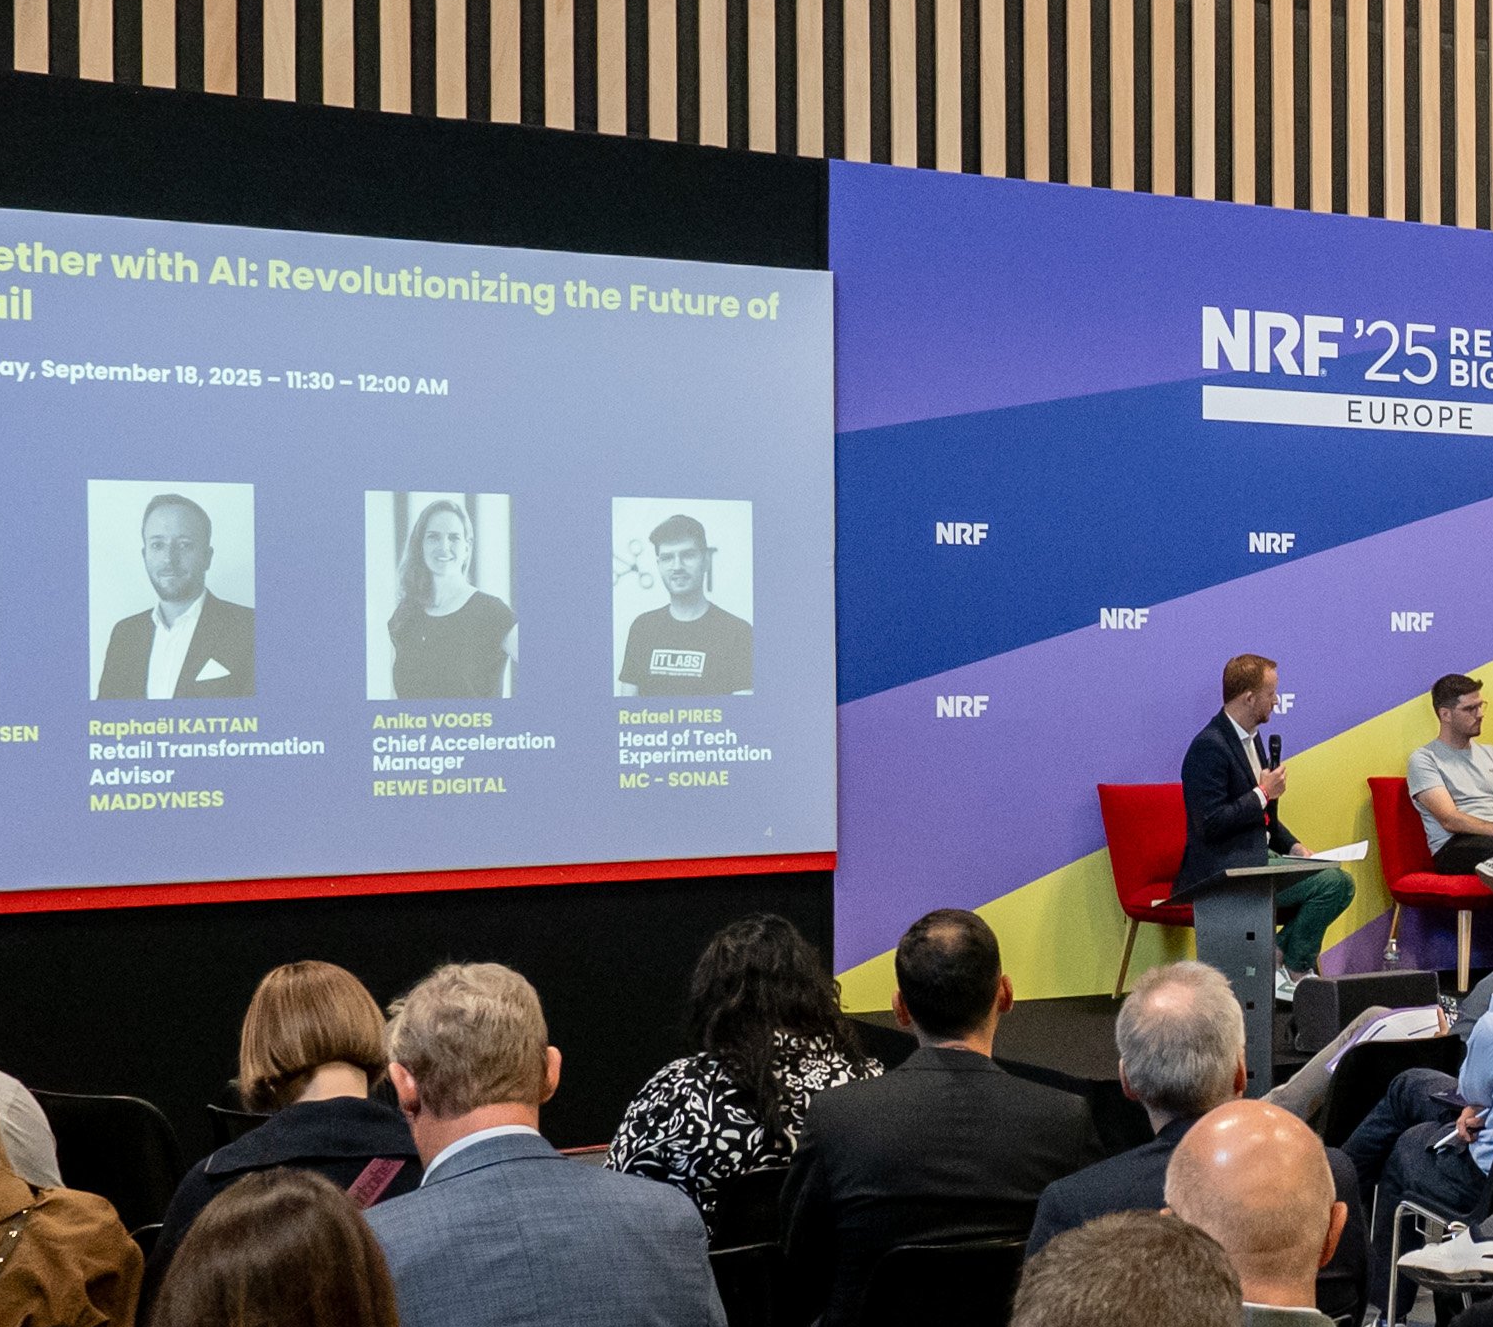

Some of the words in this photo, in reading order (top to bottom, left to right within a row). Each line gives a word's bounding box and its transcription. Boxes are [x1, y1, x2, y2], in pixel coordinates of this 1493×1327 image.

[110, 247, 199, 283] with
[209, 255, 259, 287] AI:
[268, 258, 555, 316] Revolutionizing
[563, 280, 622, 311] the
[630, 284, 740, 318] Future
[747, 292, 779, 321] of
[1202, 306, 1344, 377] NRF
[1354, 319, 1438, 385] '25
[42, 360, 171, 389] September
[175, 365, 205, 386] 18,
[209, 367, 262, 388] 2025
[286, 370, 334, 390] 11:30
[357, 374, 410, 393] 12:00
[415, 378, 448, 395] AM
[1348, 400, 1473, 429] EUROPE
[936, 521, 988, 545] NRF
[1248, 532, 1295, 554] NRF
[1100, 608, 1149, 629] NRF
[1390, 611, 1433, 632] NRF
[936, 694, 988, 717] NRF
[373, 714, 427, 729] Anika
[619, 709, 674, 724] Rafael
[678, 709, 722, 724] PIRES
[89, 718, 174, 741] Raphaël
[179, 717, 258, 735] KATTAN
[619, 730, 667, 747] Head
[671, 729, 690, 746] of
[693, 729, 737, 745] Tech
[89, 740, 153, 761] Retail
[158, 737, 325, 759] Transformation
[373, 735, 426, 753] Chief
[430, 732, 555, 752] Acceleration
[373, 753, 464, 774] Manager
[619, 745, 772, 768] Experimentation
[90, 766, 175, 786] Advisor
[373, 779, 428, 796] REWE
[432, 777, 507, 795] DIGITAL
[620, 772, 650, 789] MC
[668, 771, 729, 788] SONAE
[90, 790, 224, 811] MADDYNESS
